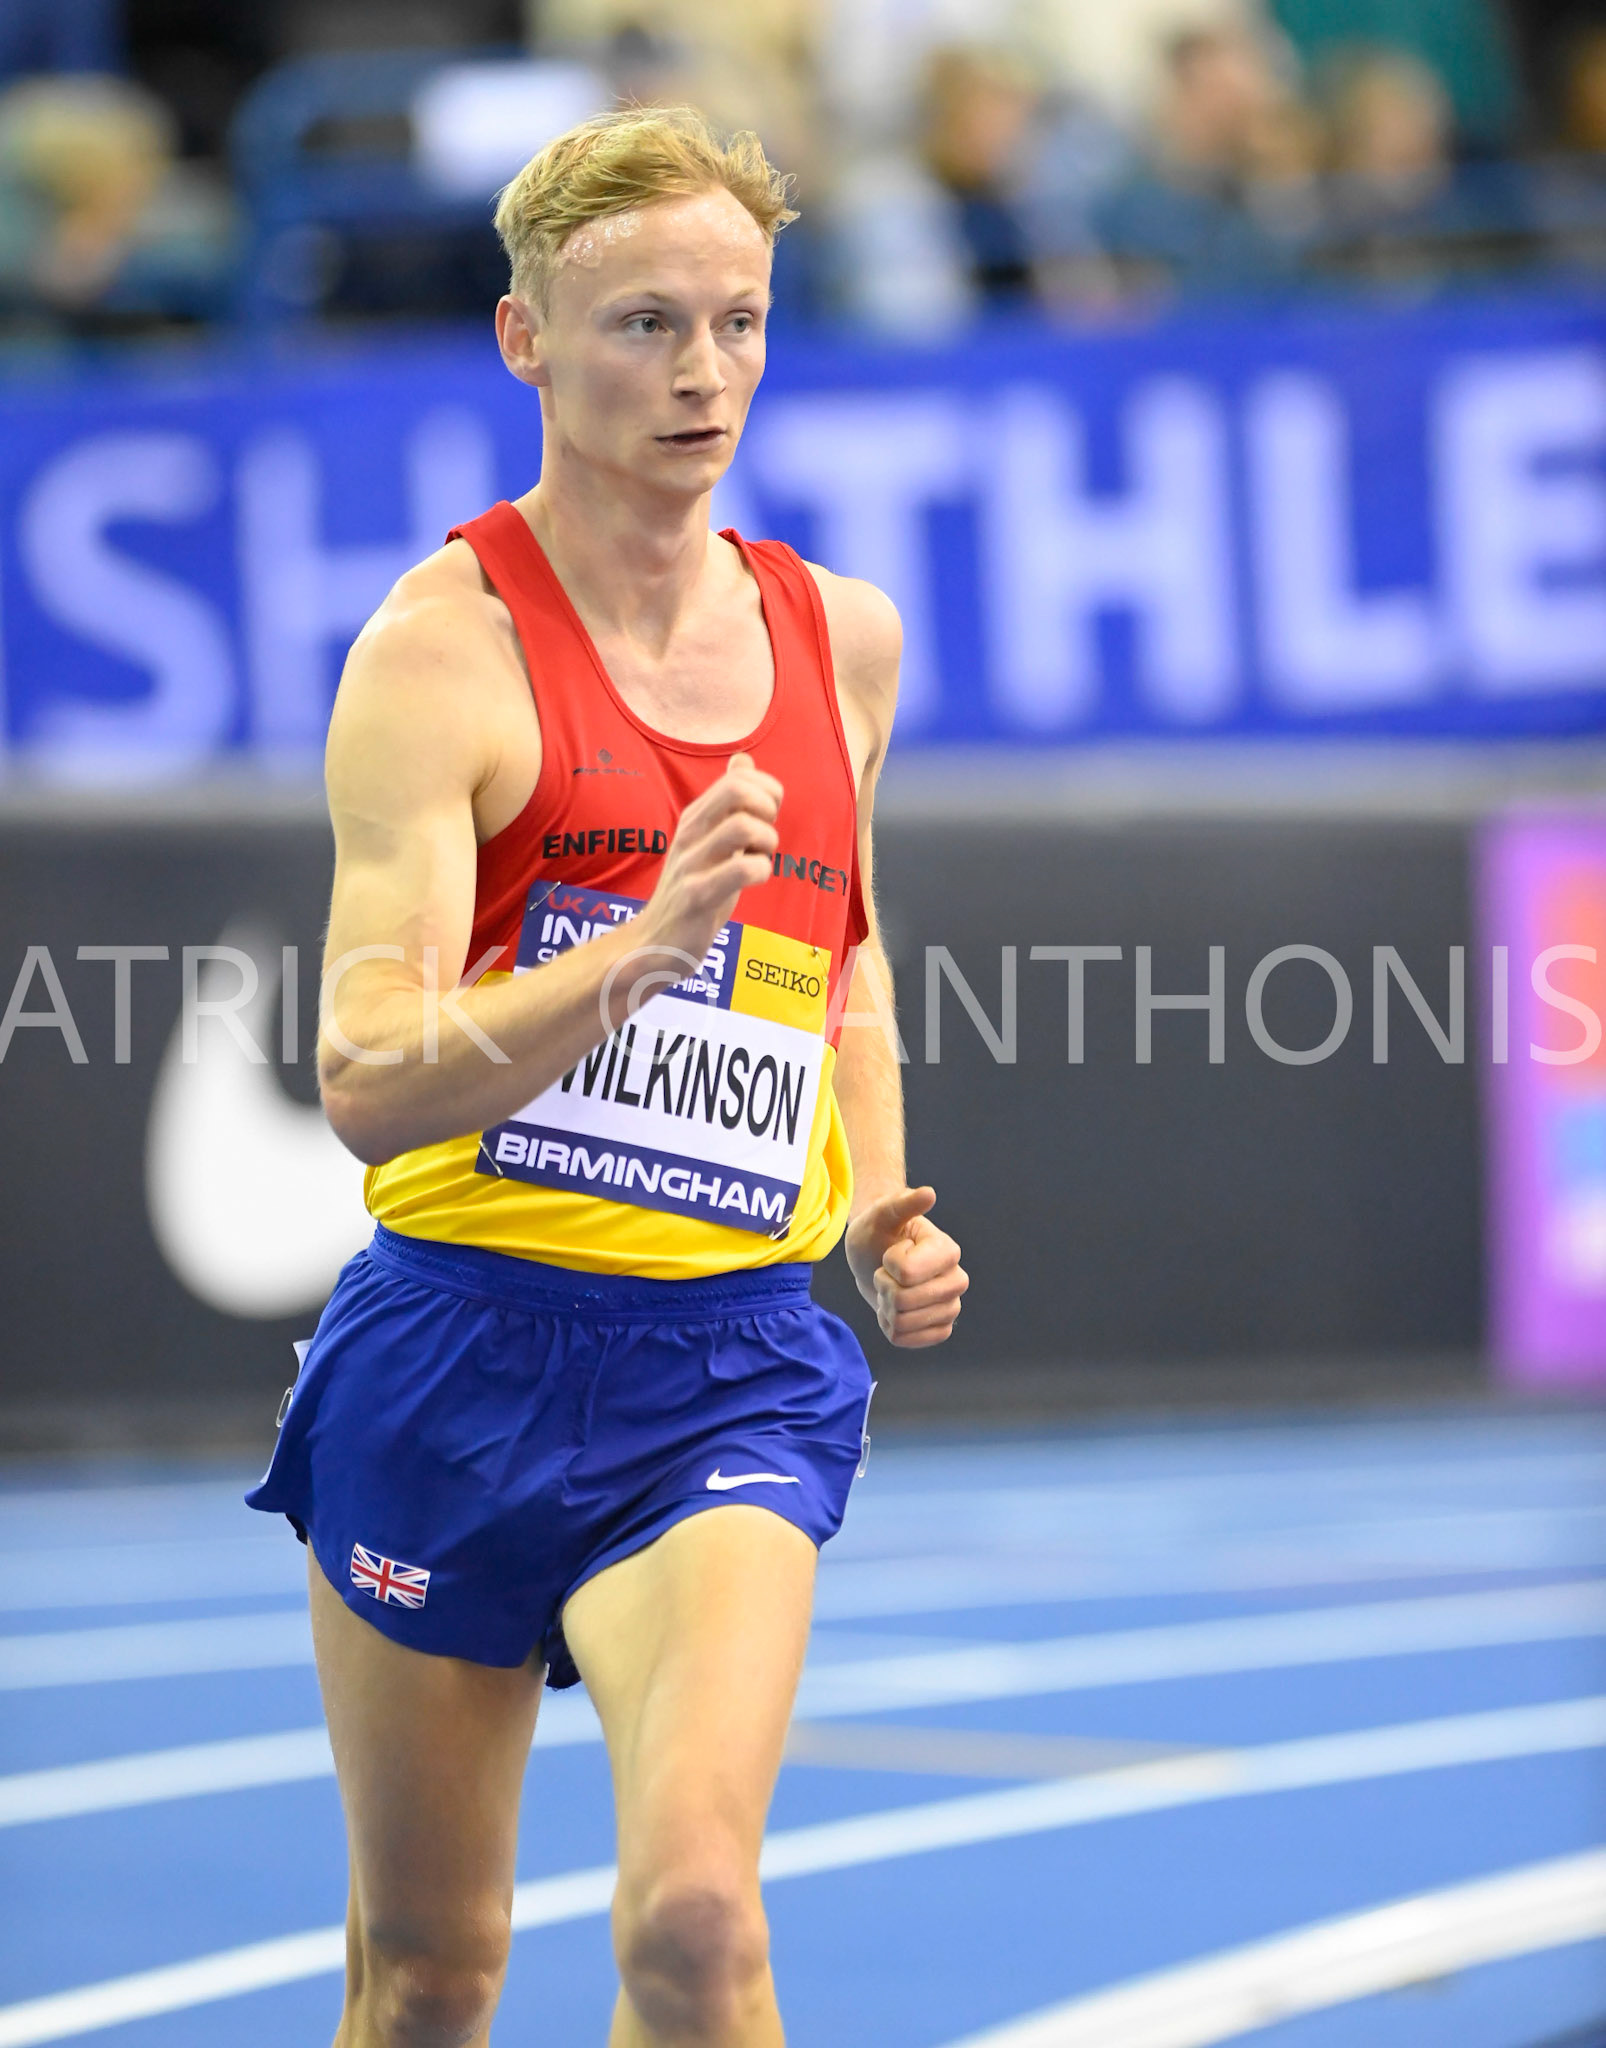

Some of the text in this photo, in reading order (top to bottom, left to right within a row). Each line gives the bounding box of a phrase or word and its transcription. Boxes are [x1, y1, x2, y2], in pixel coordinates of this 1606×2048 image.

[8, 350, 1606, 788] SH THLE
[542, 828, 849, 896] ENFIELD INGEY
[745, 958, 821, 998] SEIKO
[561, 1023, 806, 1146] WILKINSON
[495, 1132, 787, 1224] BIRMINGHAM
